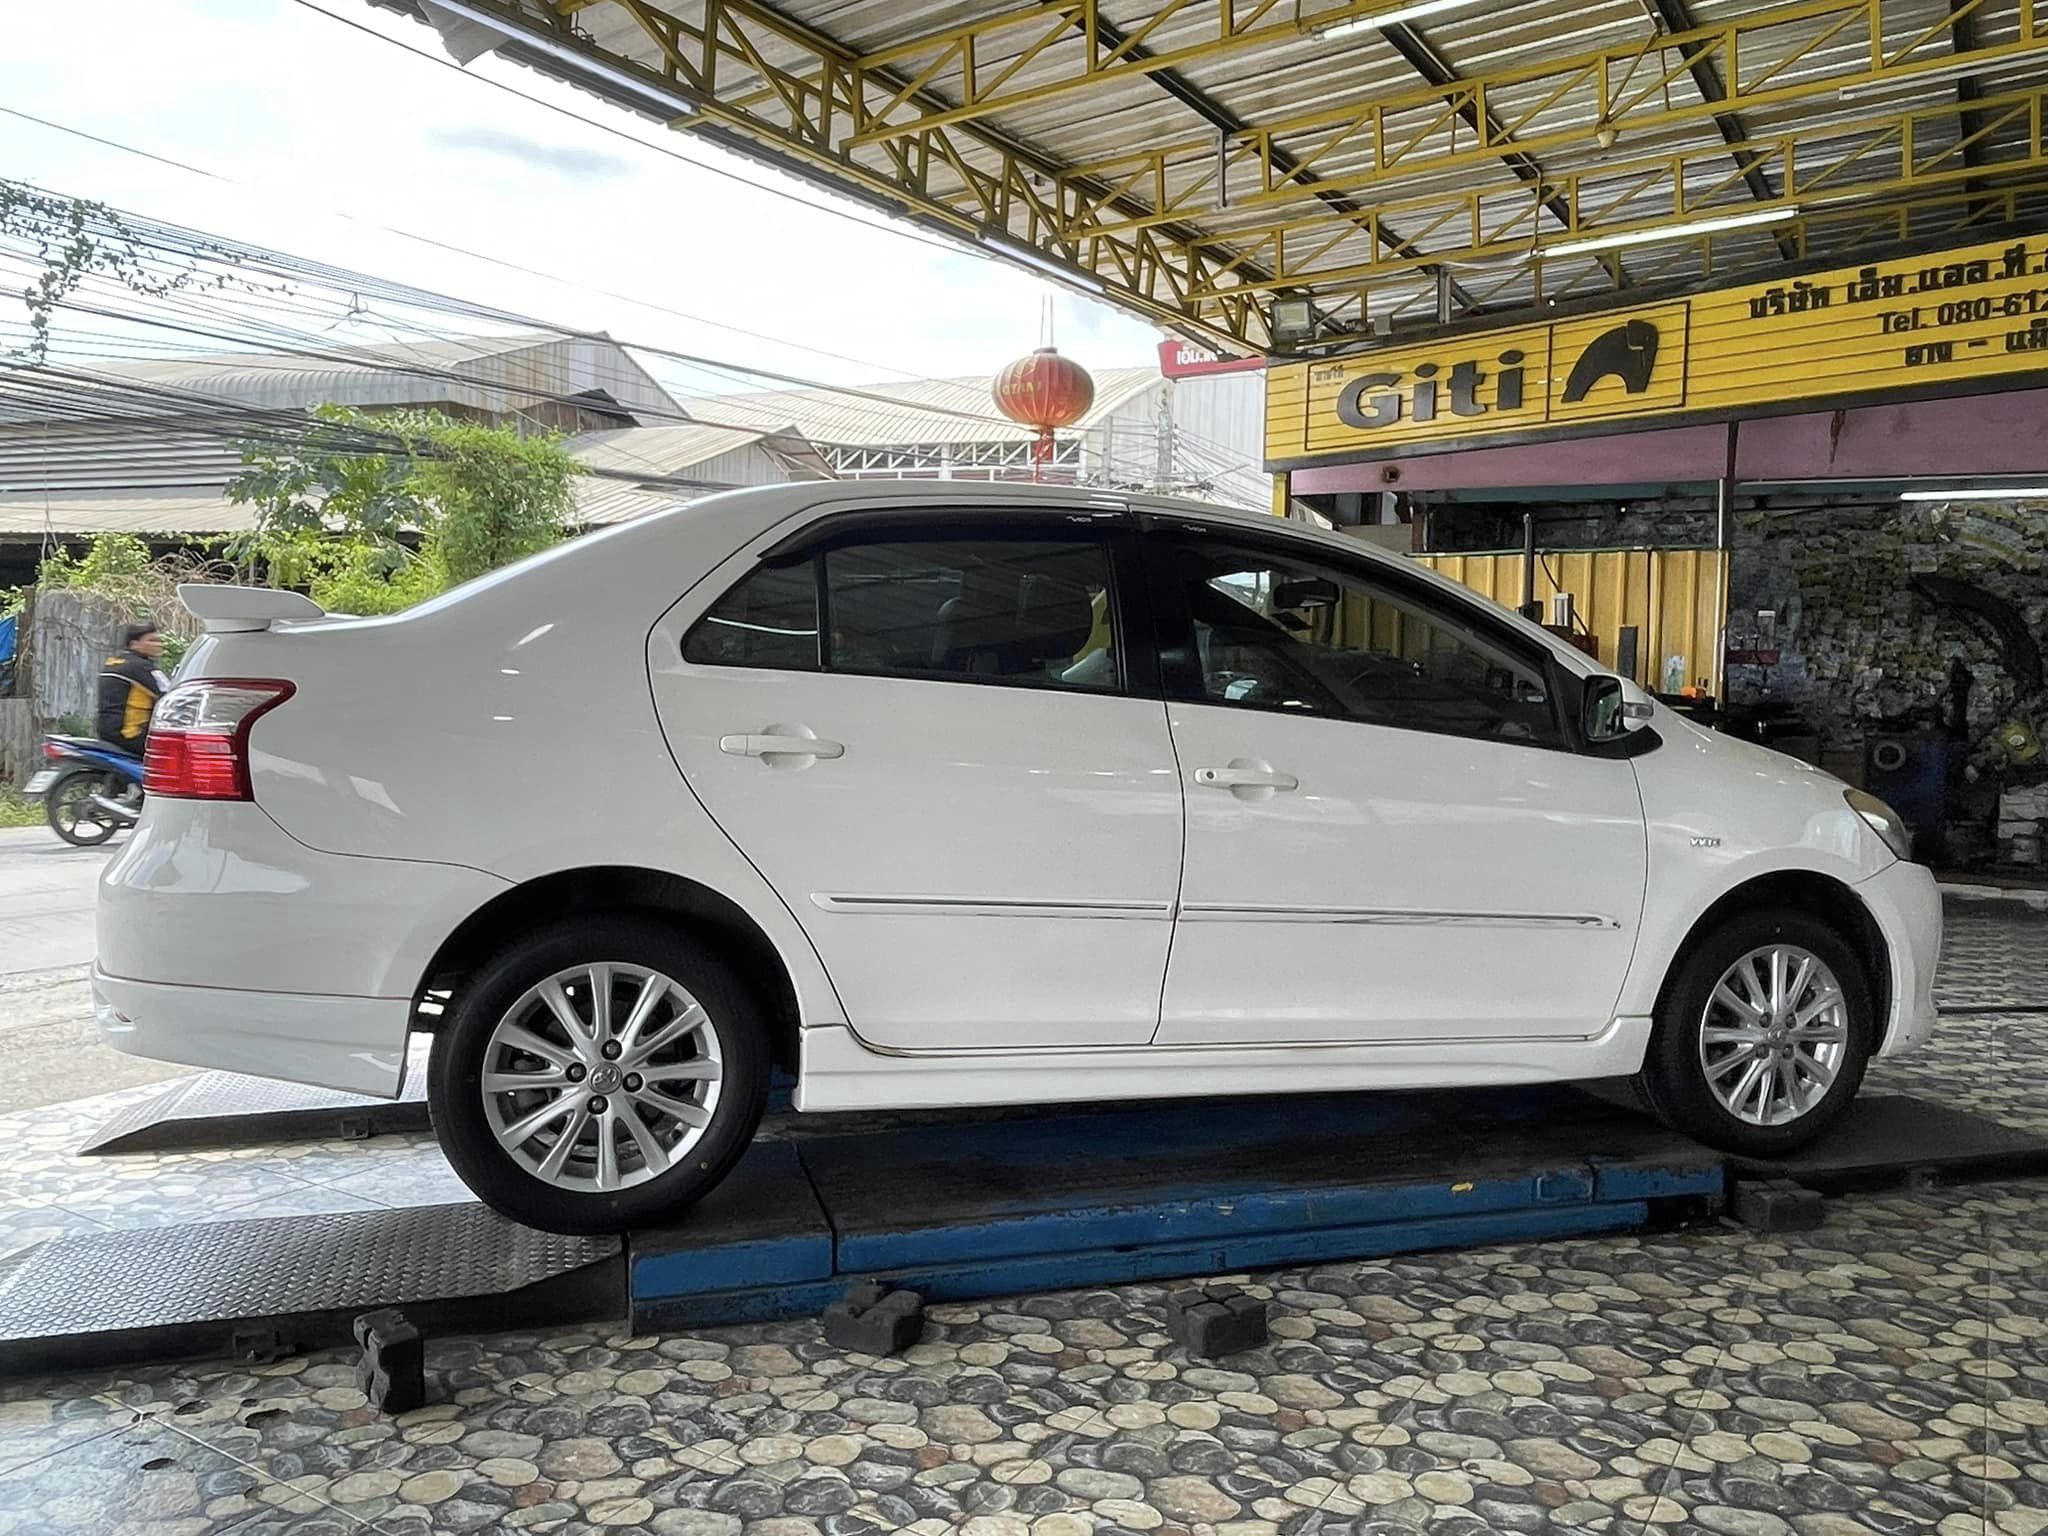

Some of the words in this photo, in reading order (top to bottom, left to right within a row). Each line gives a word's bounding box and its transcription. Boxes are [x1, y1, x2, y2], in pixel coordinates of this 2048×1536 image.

[1750, 281, 1830, 318] บริษัท
[1877, 307, 1928, 335] Tel.
[1905, 341, 1953, 367] ยาง
[1337, 350, 1524, 430] Giti
